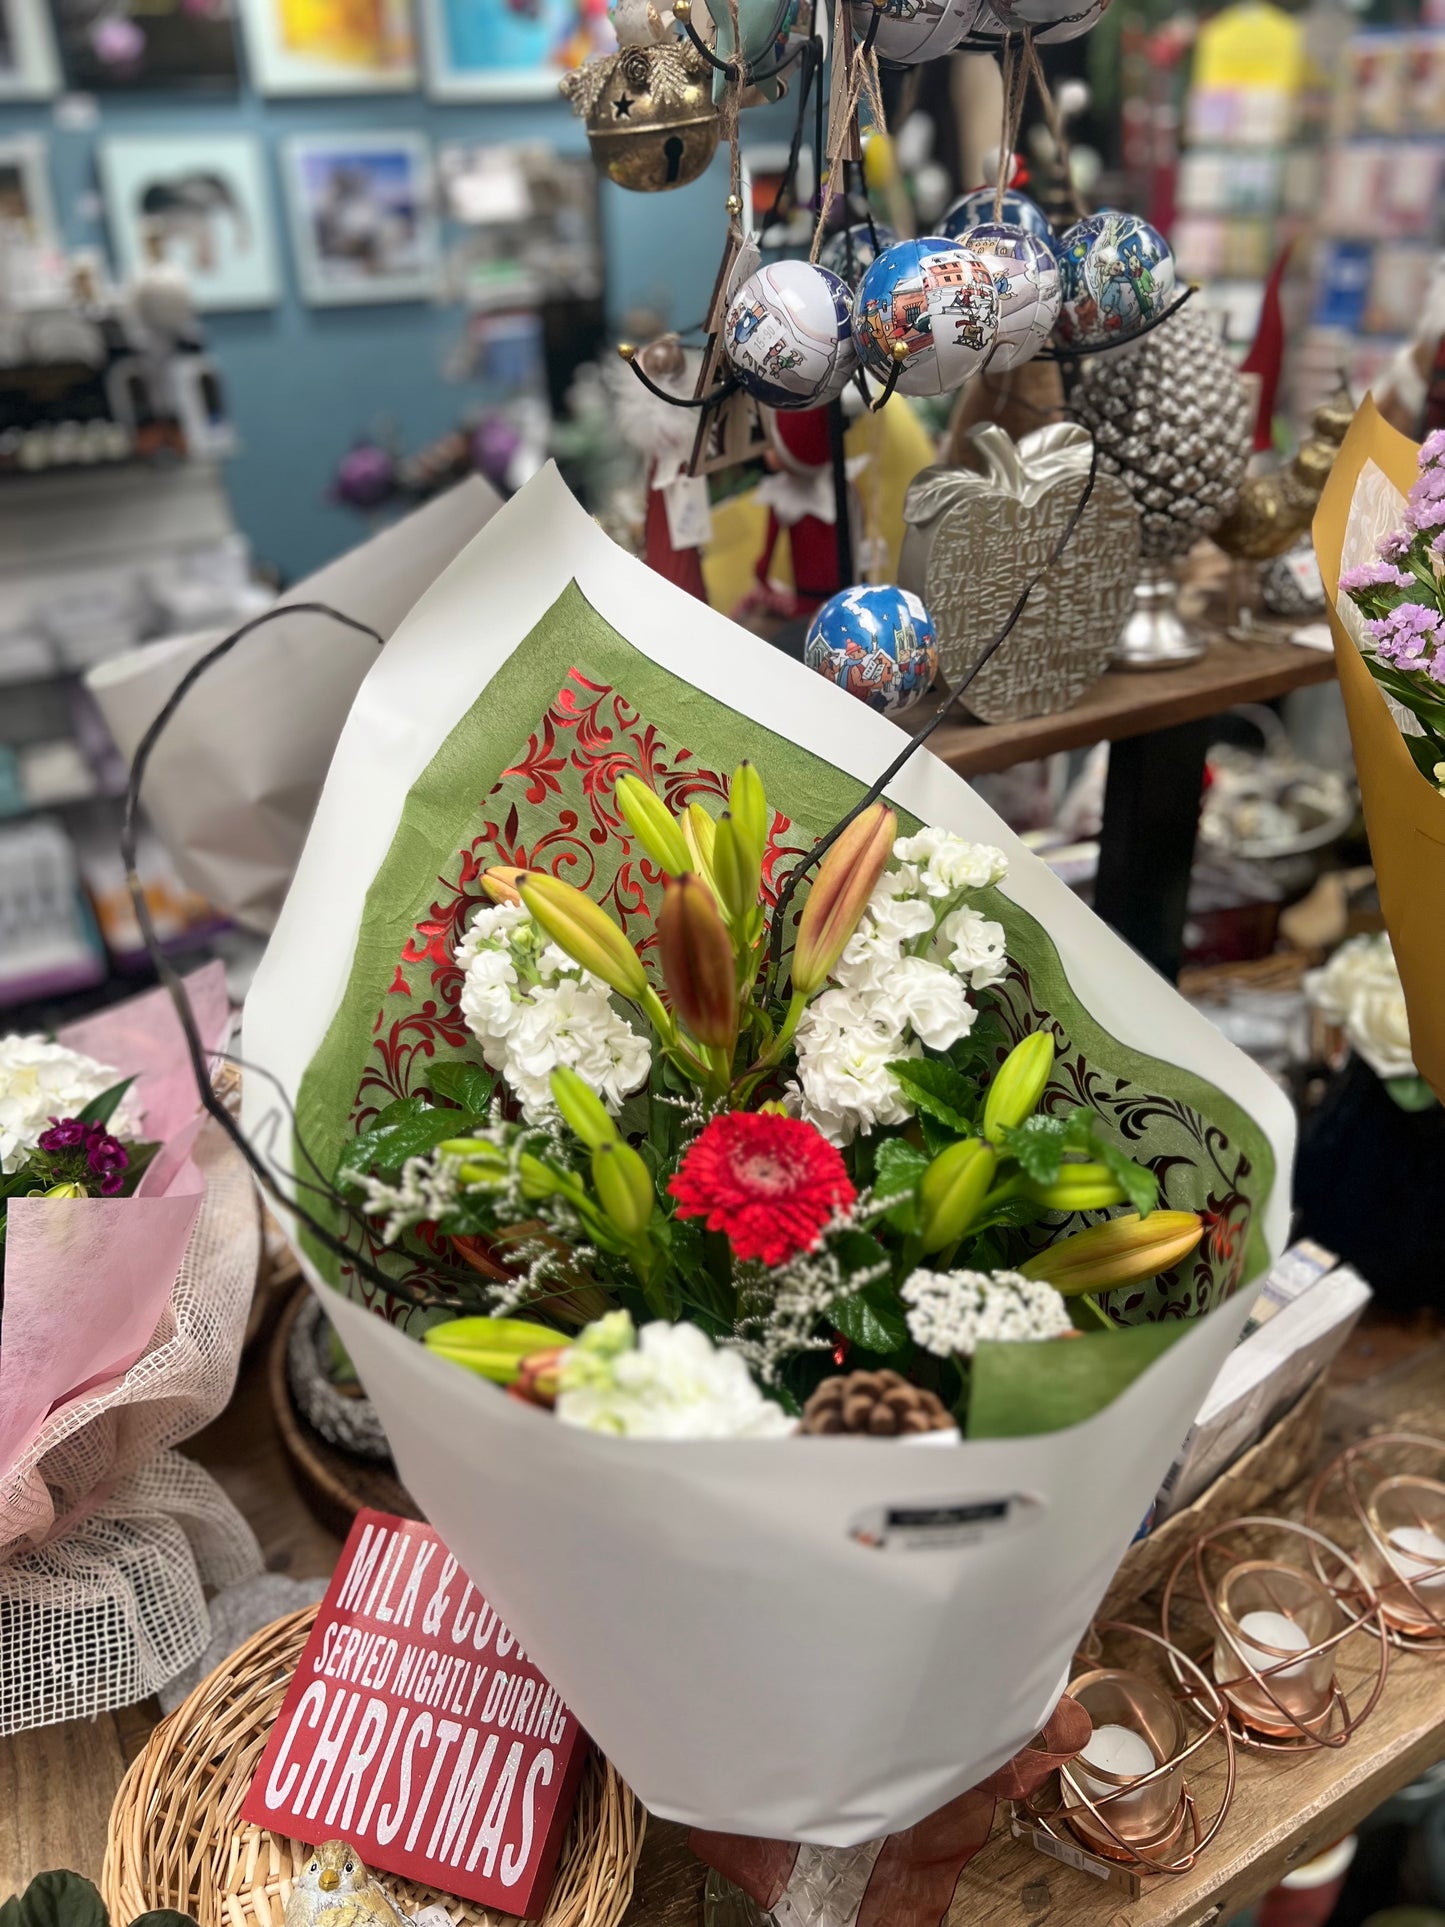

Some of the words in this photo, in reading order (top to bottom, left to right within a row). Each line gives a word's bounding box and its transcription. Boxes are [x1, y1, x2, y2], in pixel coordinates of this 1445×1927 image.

[998, 497, 1065, 532] LOVE
[1016, 540, 1058, 566] LOV
[335, 1524, 438, 1627] MILK
[422, 1552, 459, 1637] &
[313, 1621, 397, 1691] SERVED
[391, 1644, 488, 1716] NIGHTLY
[481, 1669, 570, 1744] DURING
[264, 1680, 554, 1888] CHRISTMAS
